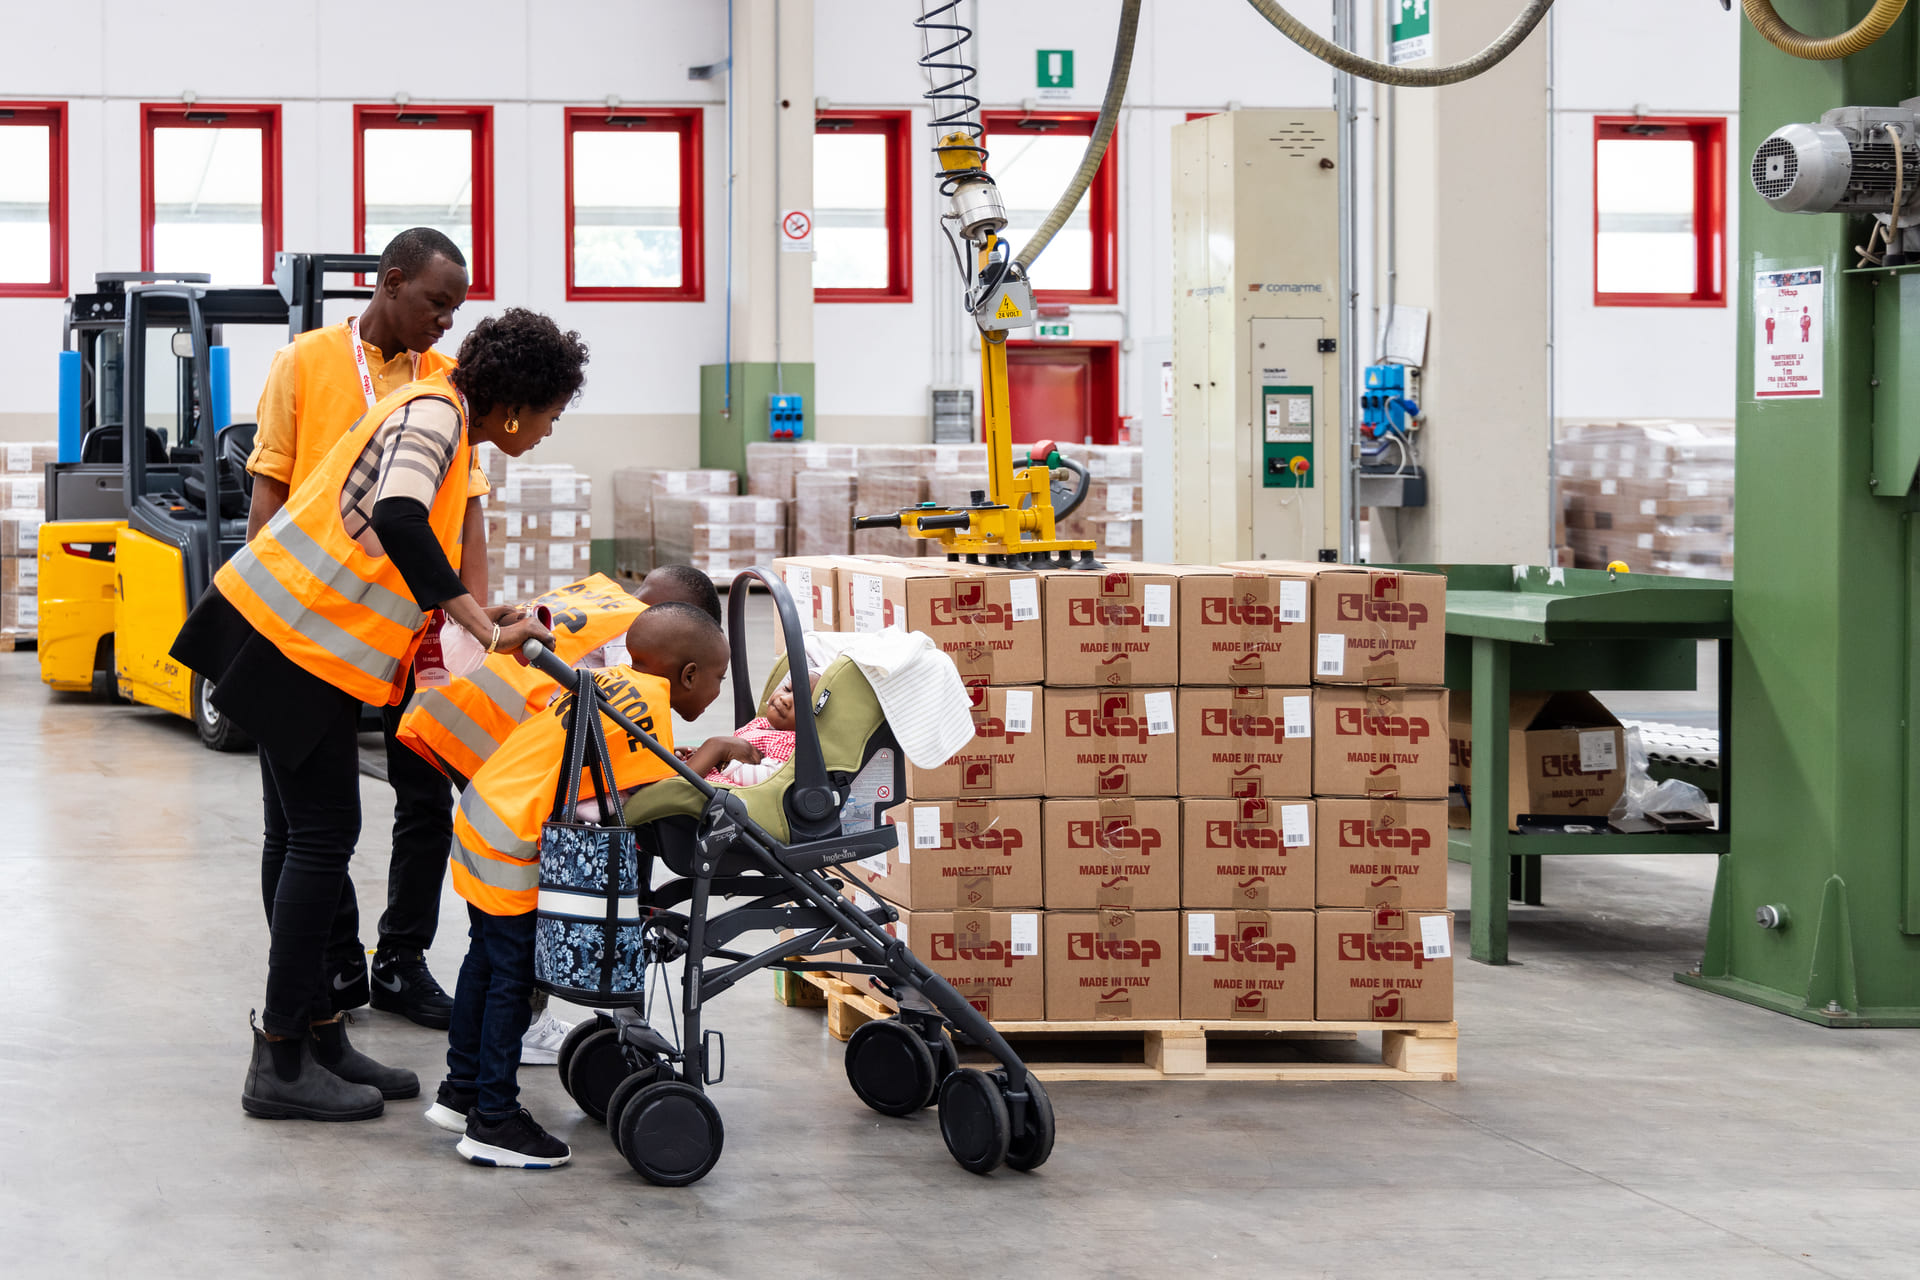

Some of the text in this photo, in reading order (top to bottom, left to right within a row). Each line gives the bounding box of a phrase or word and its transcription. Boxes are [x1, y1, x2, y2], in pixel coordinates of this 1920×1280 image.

[1267, 283, 1322, 293] comarme
[1006, 310, 1020, 318] VOLT
[1080, 642, 1150, 653] MADE IN ITALY
[1212, 642, 1282, 652] MADE IN ITALY
[1347, 638, 1376, 649] MADE
[1378, 639, 1389, 649] IN
[1391, 639, 1417, 650] ITALY
[1077, 753, 1148, 764] MADE IN ITALY
[1212, 753, 1283, 764] MADE IN ITALY
[1347, 752, 1419, 764] MADE IN ITALY
[1551, 788, 1604, 798] MADE IN ITALY
[822, 849, 857, 863] Inglesina
[1079, 865, 1150, 875] MADE IN ITALY
[1216, 865, 1287, 876] MADE IN ITALY
[1349, 864, 1420, 875] MADE IN ITALY
[1079, 976, 1150, 987] MADE IN ITALY
[1213, 979, 1285, 990] MADE IN ITALY
[1350, 977, 1423, 989] MADE IN ITALY
